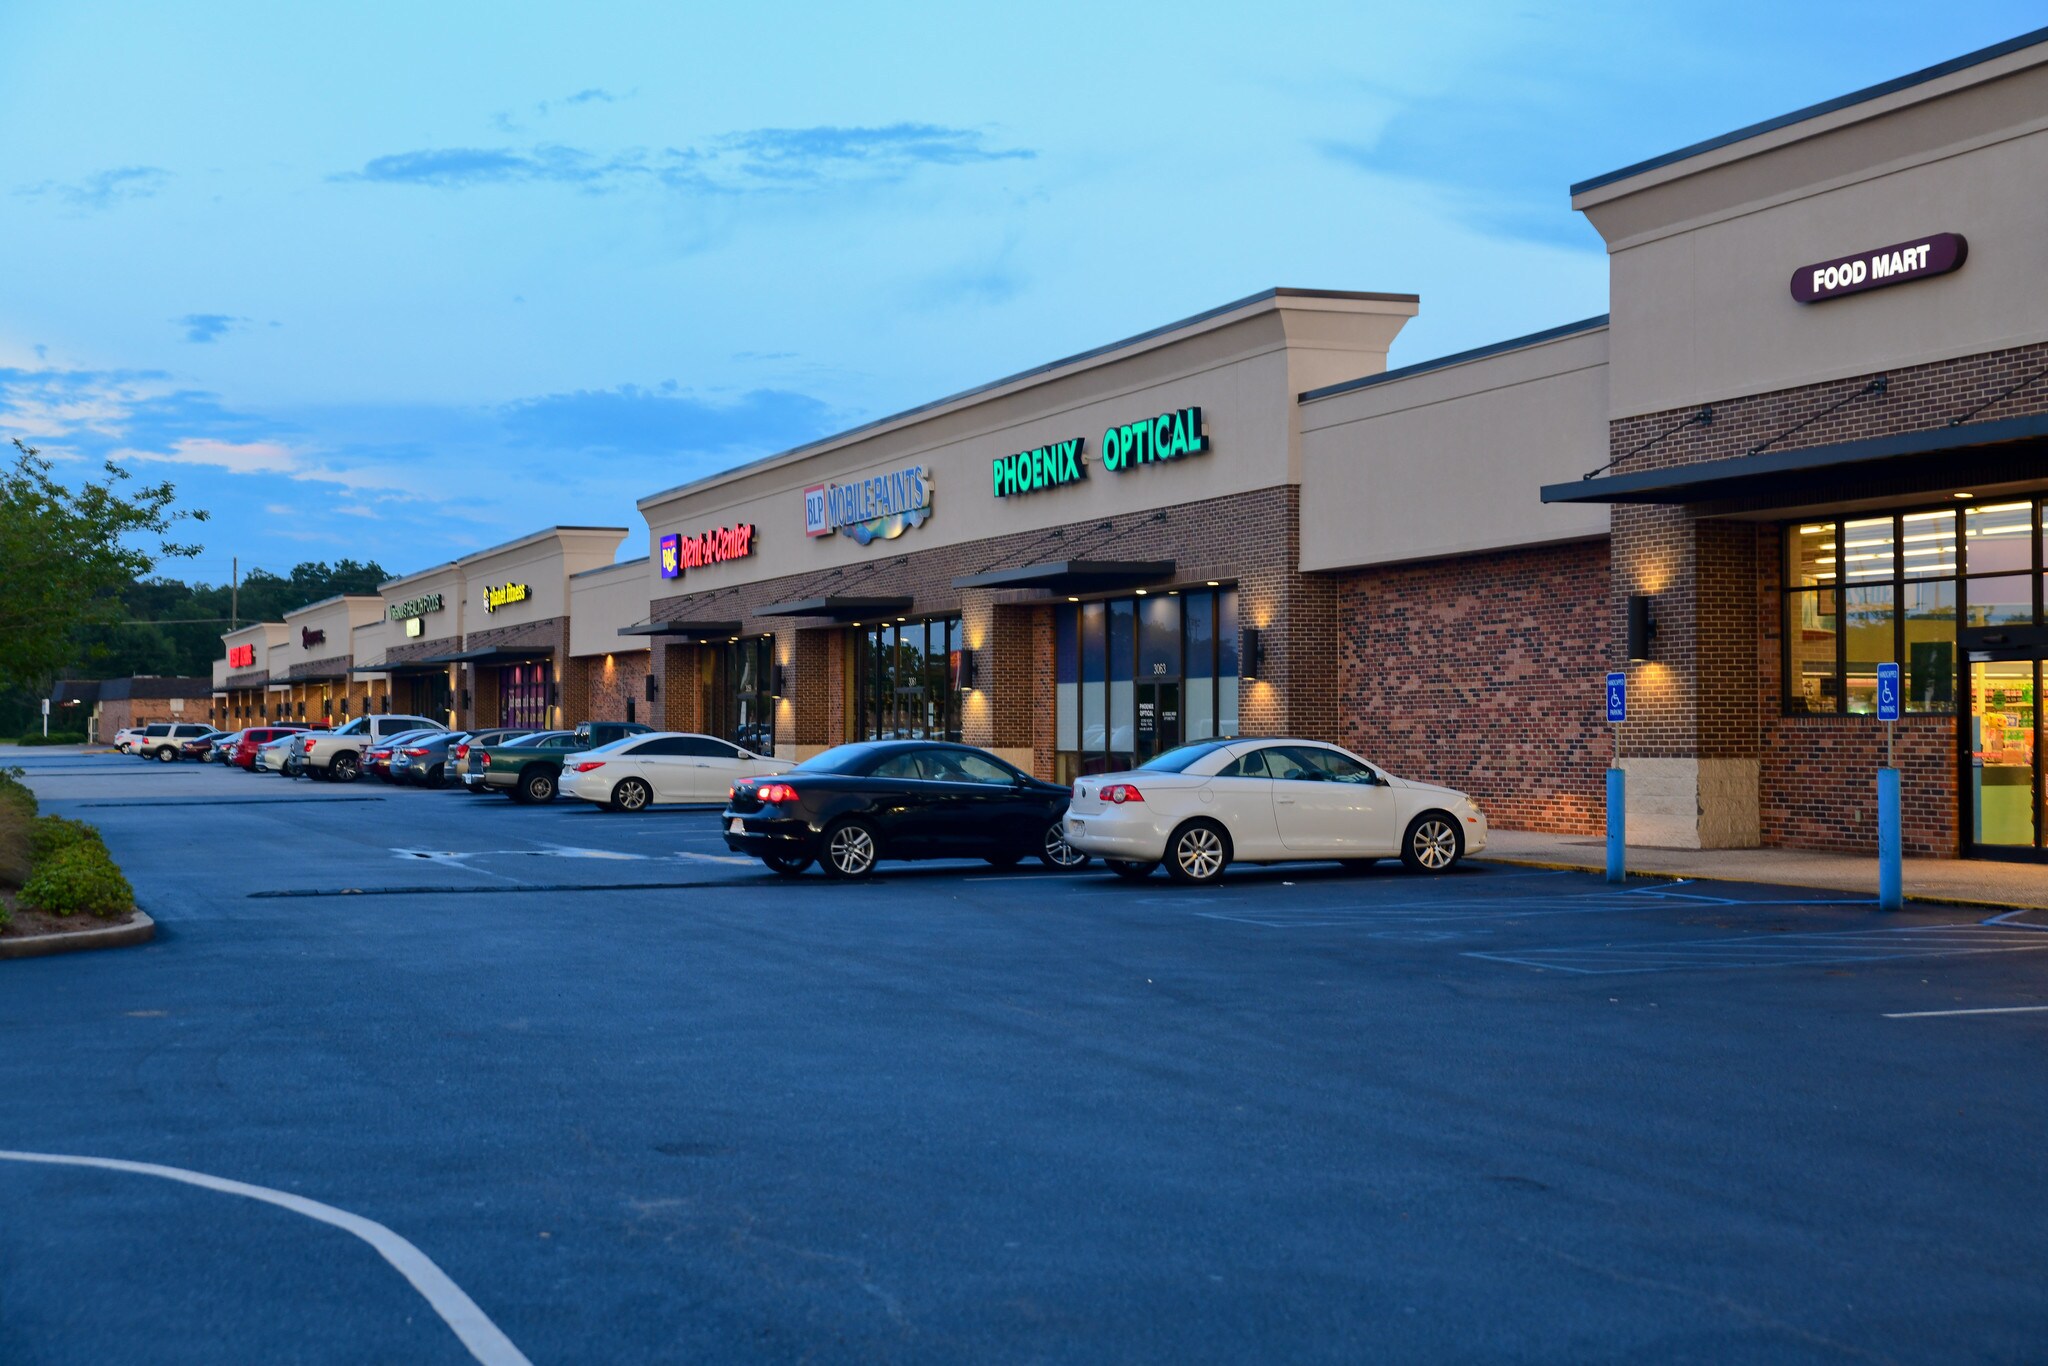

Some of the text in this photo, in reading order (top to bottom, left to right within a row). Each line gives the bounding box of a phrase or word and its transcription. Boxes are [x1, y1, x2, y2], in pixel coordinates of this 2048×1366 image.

[1813, 244, 1930, 293] FOOD MART
[993, 408, 1202, 497] PHOENIX OPTICAL
[807, 466, 924, 527] BLP MOBILE PAINTS
